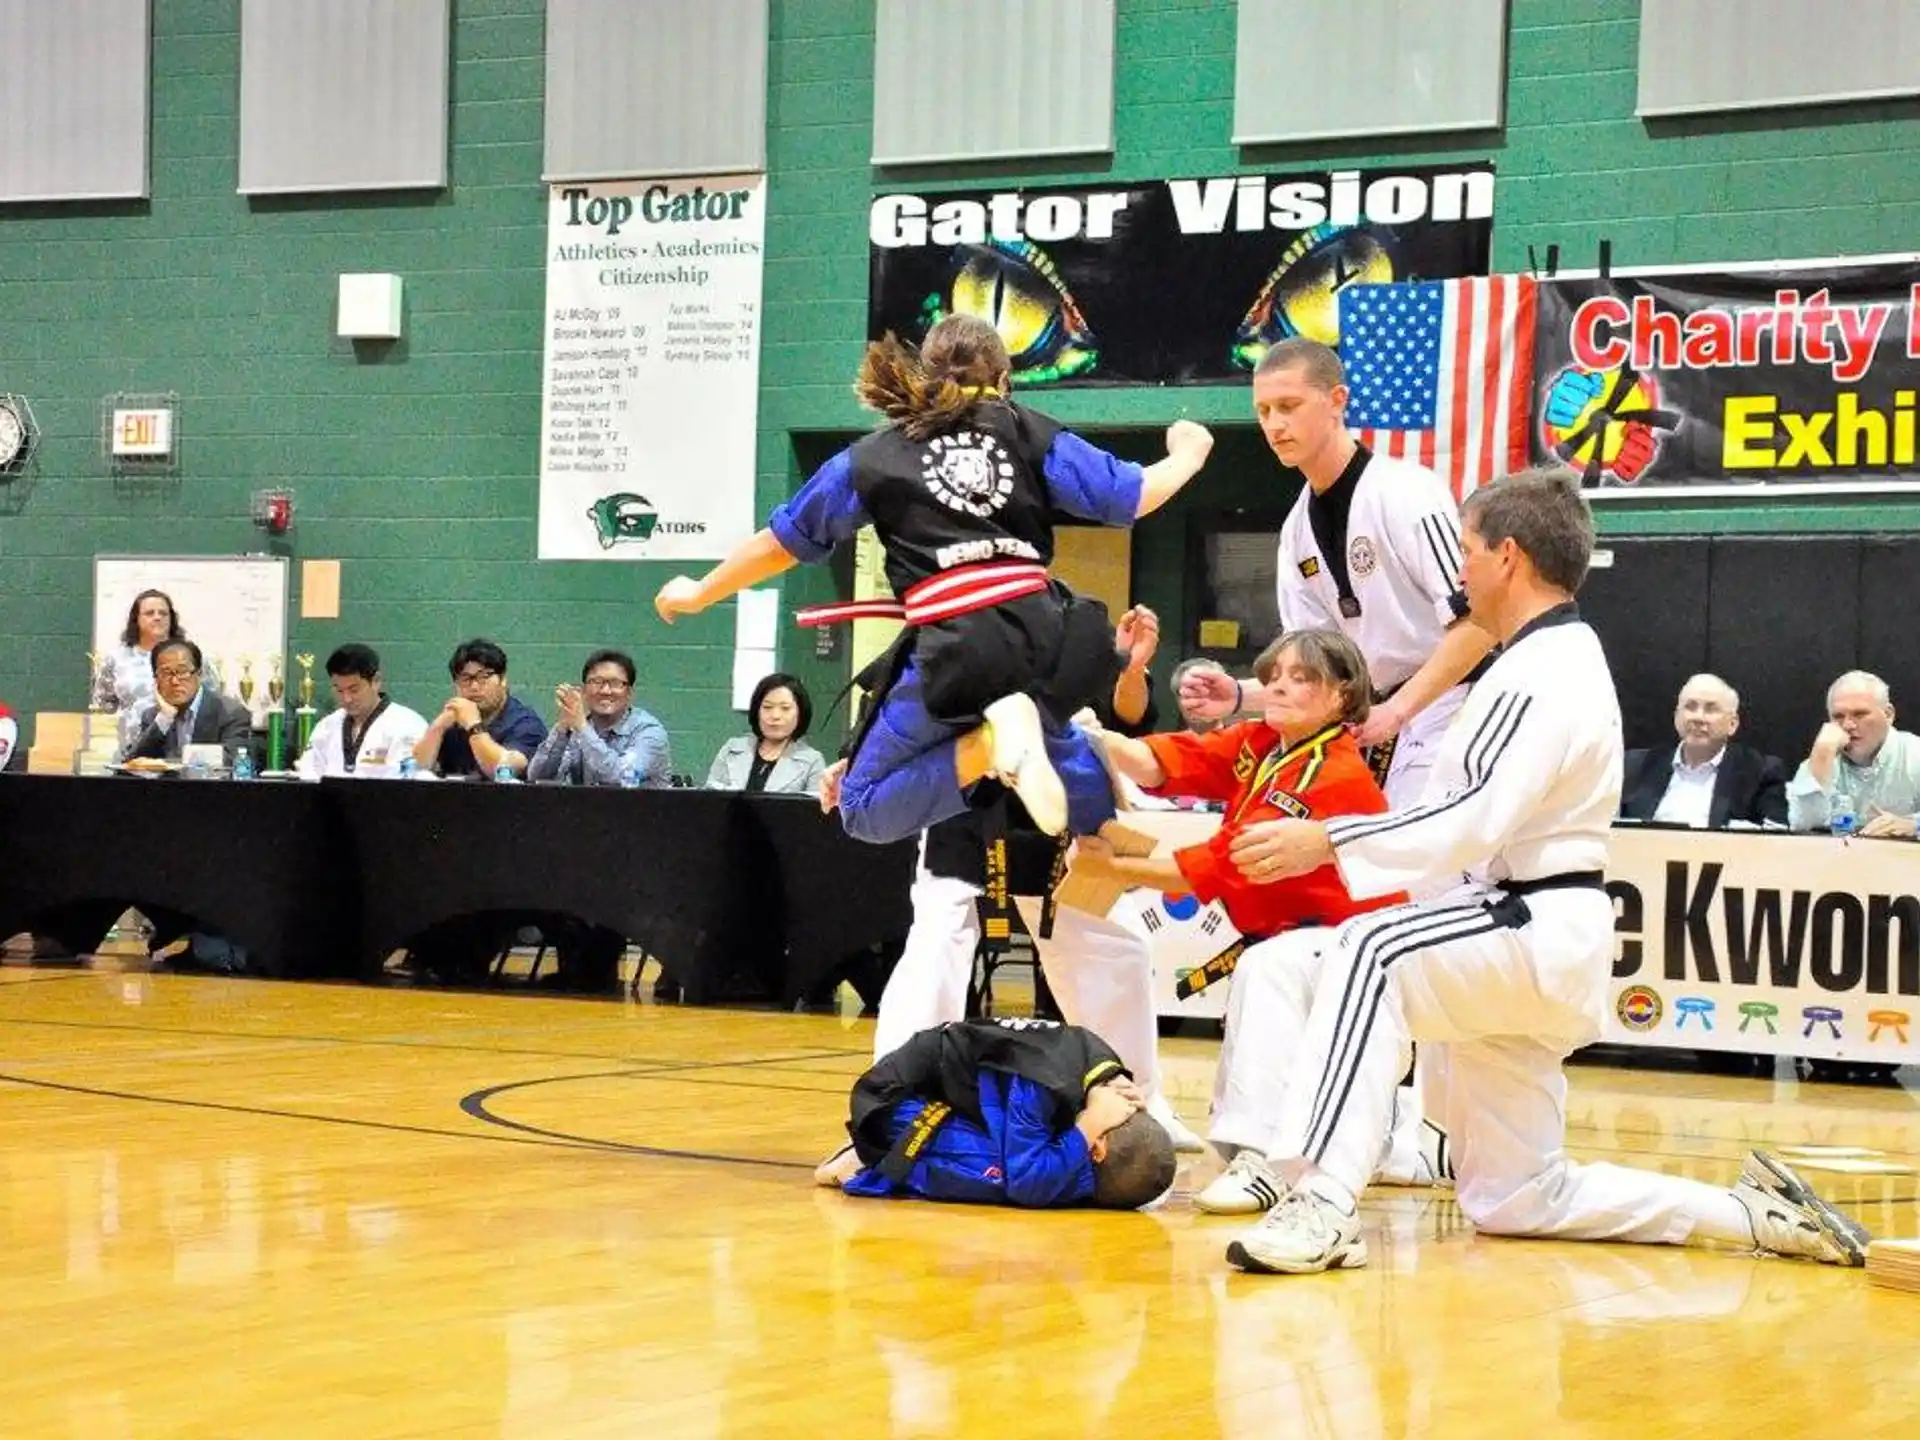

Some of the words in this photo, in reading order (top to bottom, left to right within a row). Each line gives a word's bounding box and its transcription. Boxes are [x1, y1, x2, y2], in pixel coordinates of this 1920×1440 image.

[562, 187, 633, 235] Top
[642, 185, 750, 224] Gator
[870, 191, 1128, 248] Gator
[1167, 169, 1495, 235] Vision
[553, 242, 638, 262] Athletics
[652, 237, 760, 258] Academics
[599, 265, 709, 286] Citizenship
[1570, 288, 1891, 383] Charity
[123, 414, 158, 445] EXIT
[1723, 389, 1917, 469] Exhi
[1664, 860, 1920, 996] Kwon
